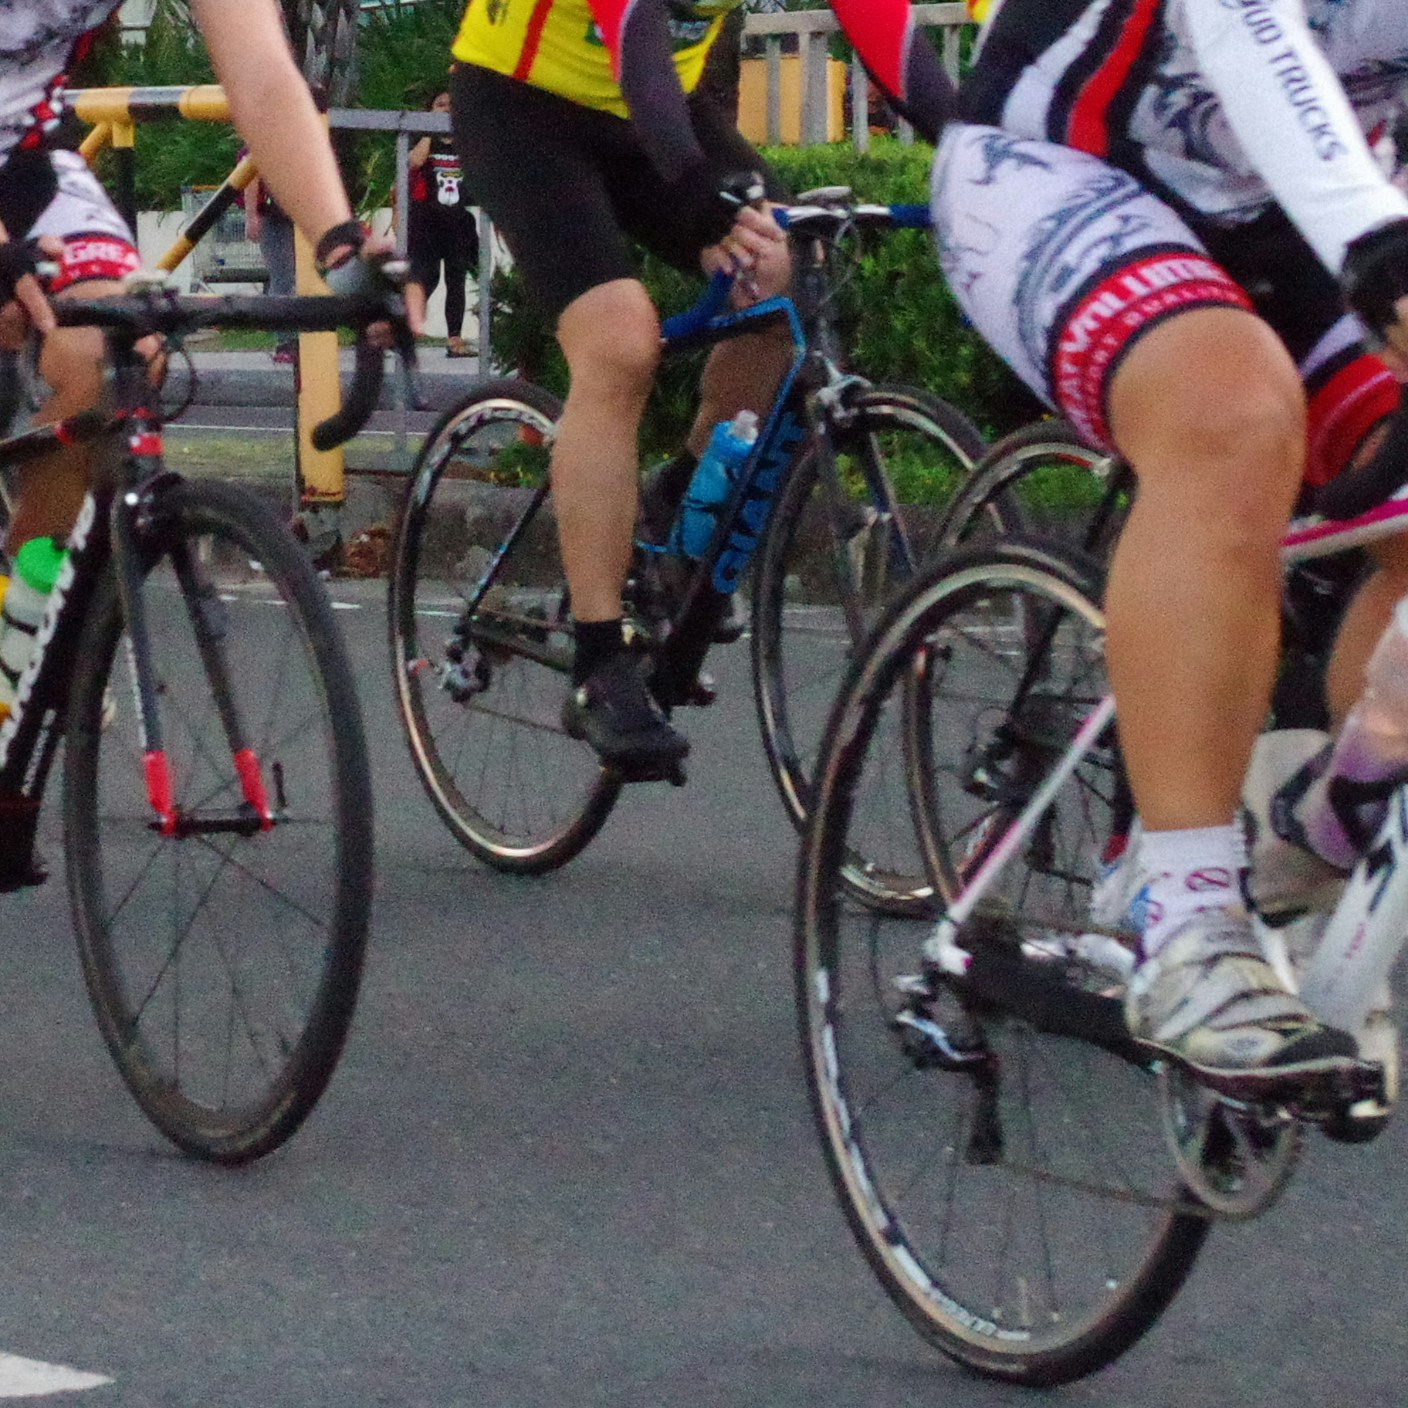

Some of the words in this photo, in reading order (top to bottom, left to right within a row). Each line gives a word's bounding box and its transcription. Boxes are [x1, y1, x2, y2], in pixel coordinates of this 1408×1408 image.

[1244, 8, 1283, 44] UD
[1269, 44, 1350, 162] TRUCKS
[64, 241, 141, 267] GREA
[713, 412, 806, 594] GIANT
